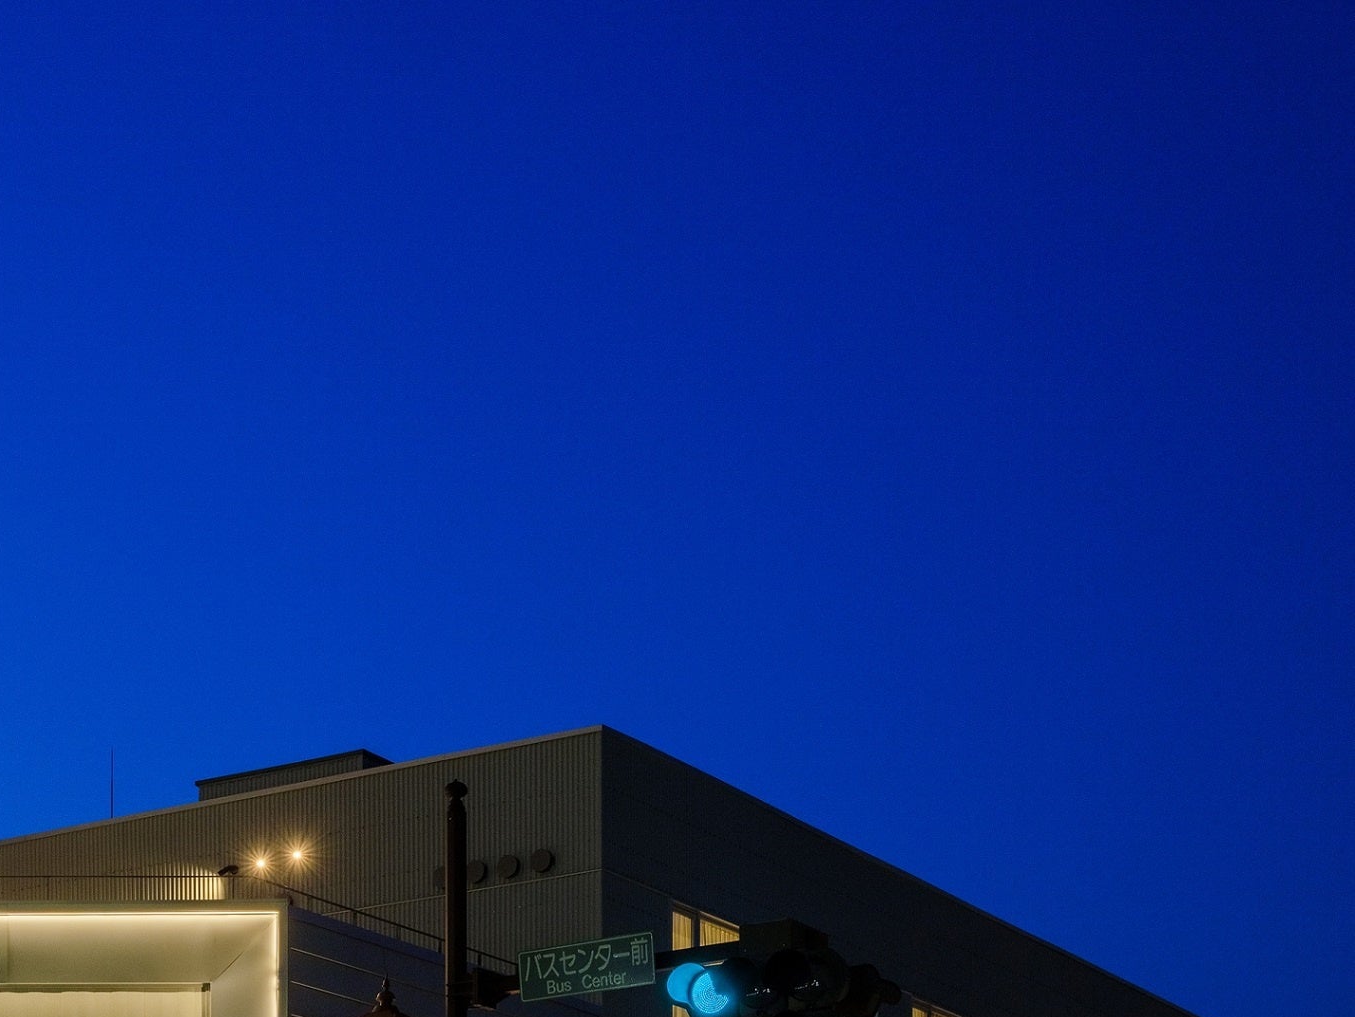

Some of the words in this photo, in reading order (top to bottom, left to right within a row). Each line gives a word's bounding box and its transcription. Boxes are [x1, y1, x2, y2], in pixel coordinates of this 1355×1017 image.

[525, 937, 649, 982] バスセンター前
[546, 979, 572, 995] Bus
[581, 971, 627, 989] Center
